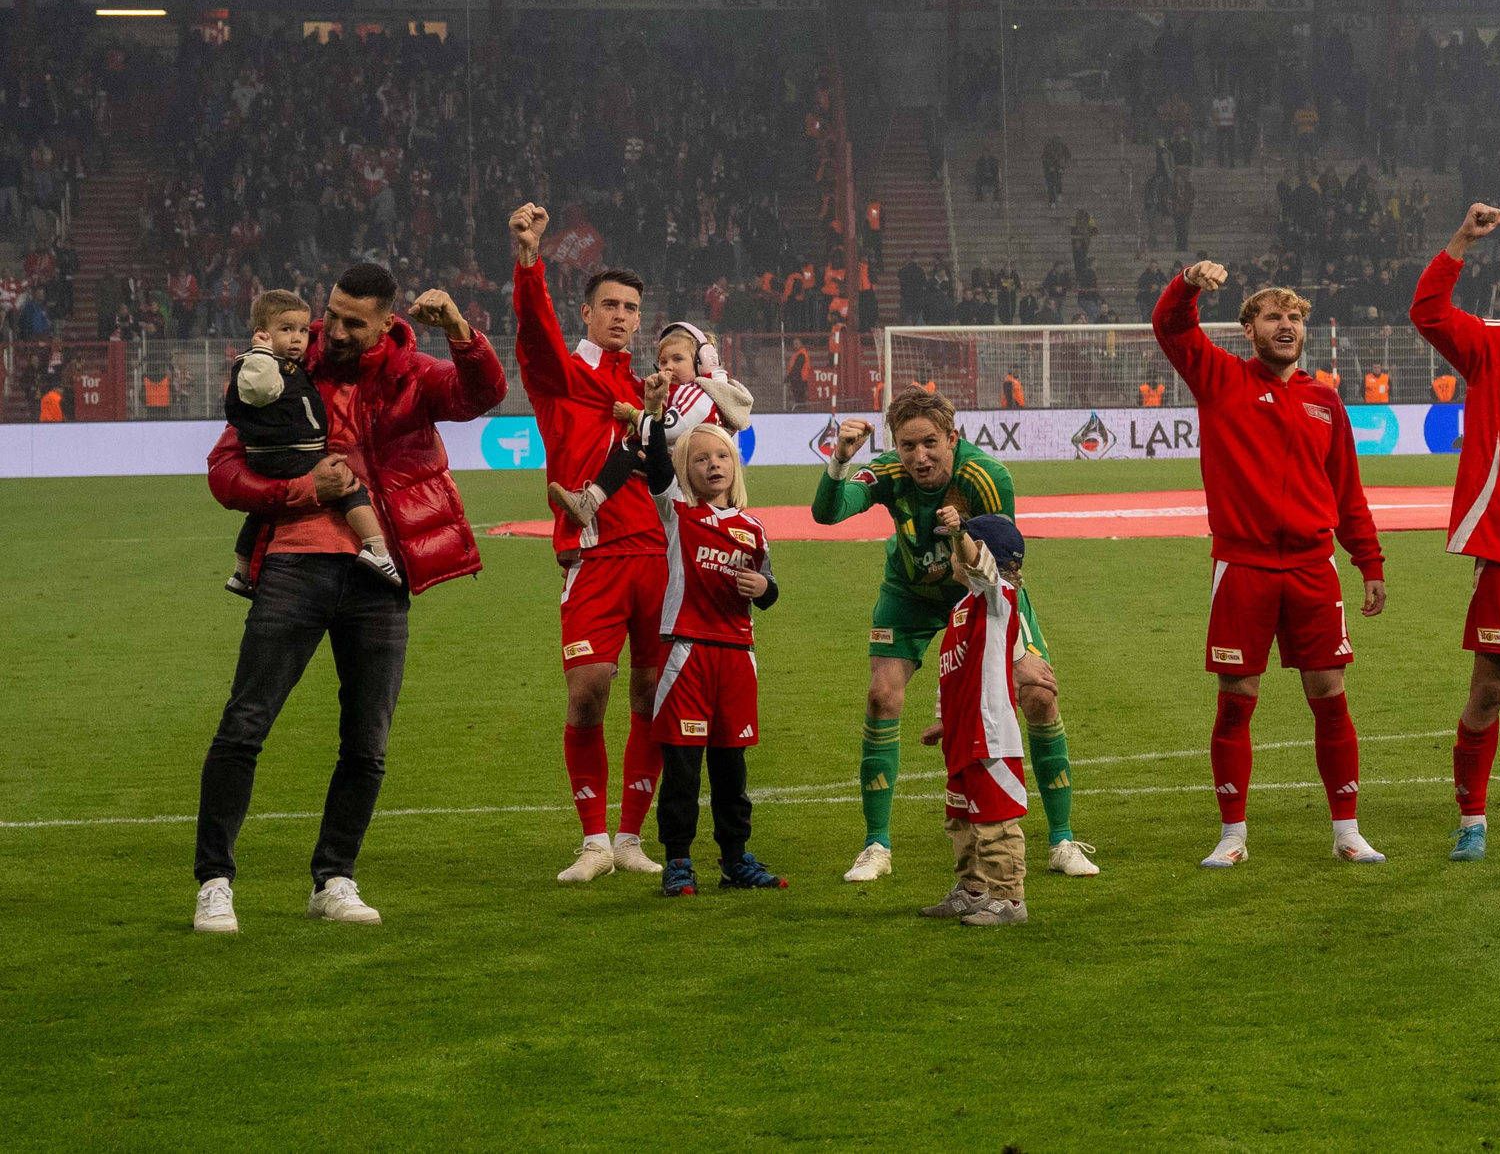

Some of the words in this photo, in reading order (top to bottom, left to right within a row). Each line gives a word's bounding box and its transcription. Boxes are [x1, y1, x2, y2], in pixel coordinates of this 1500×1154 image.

[80, 376, 101, 389] Tor
[814, 371, 834, 382] Tor
[817, 386, 830, 398] 11
[82, 392, 100, 405] 10
[696, 546, 753, 569] proAF
[701, 561, 718, 570] ALTE
